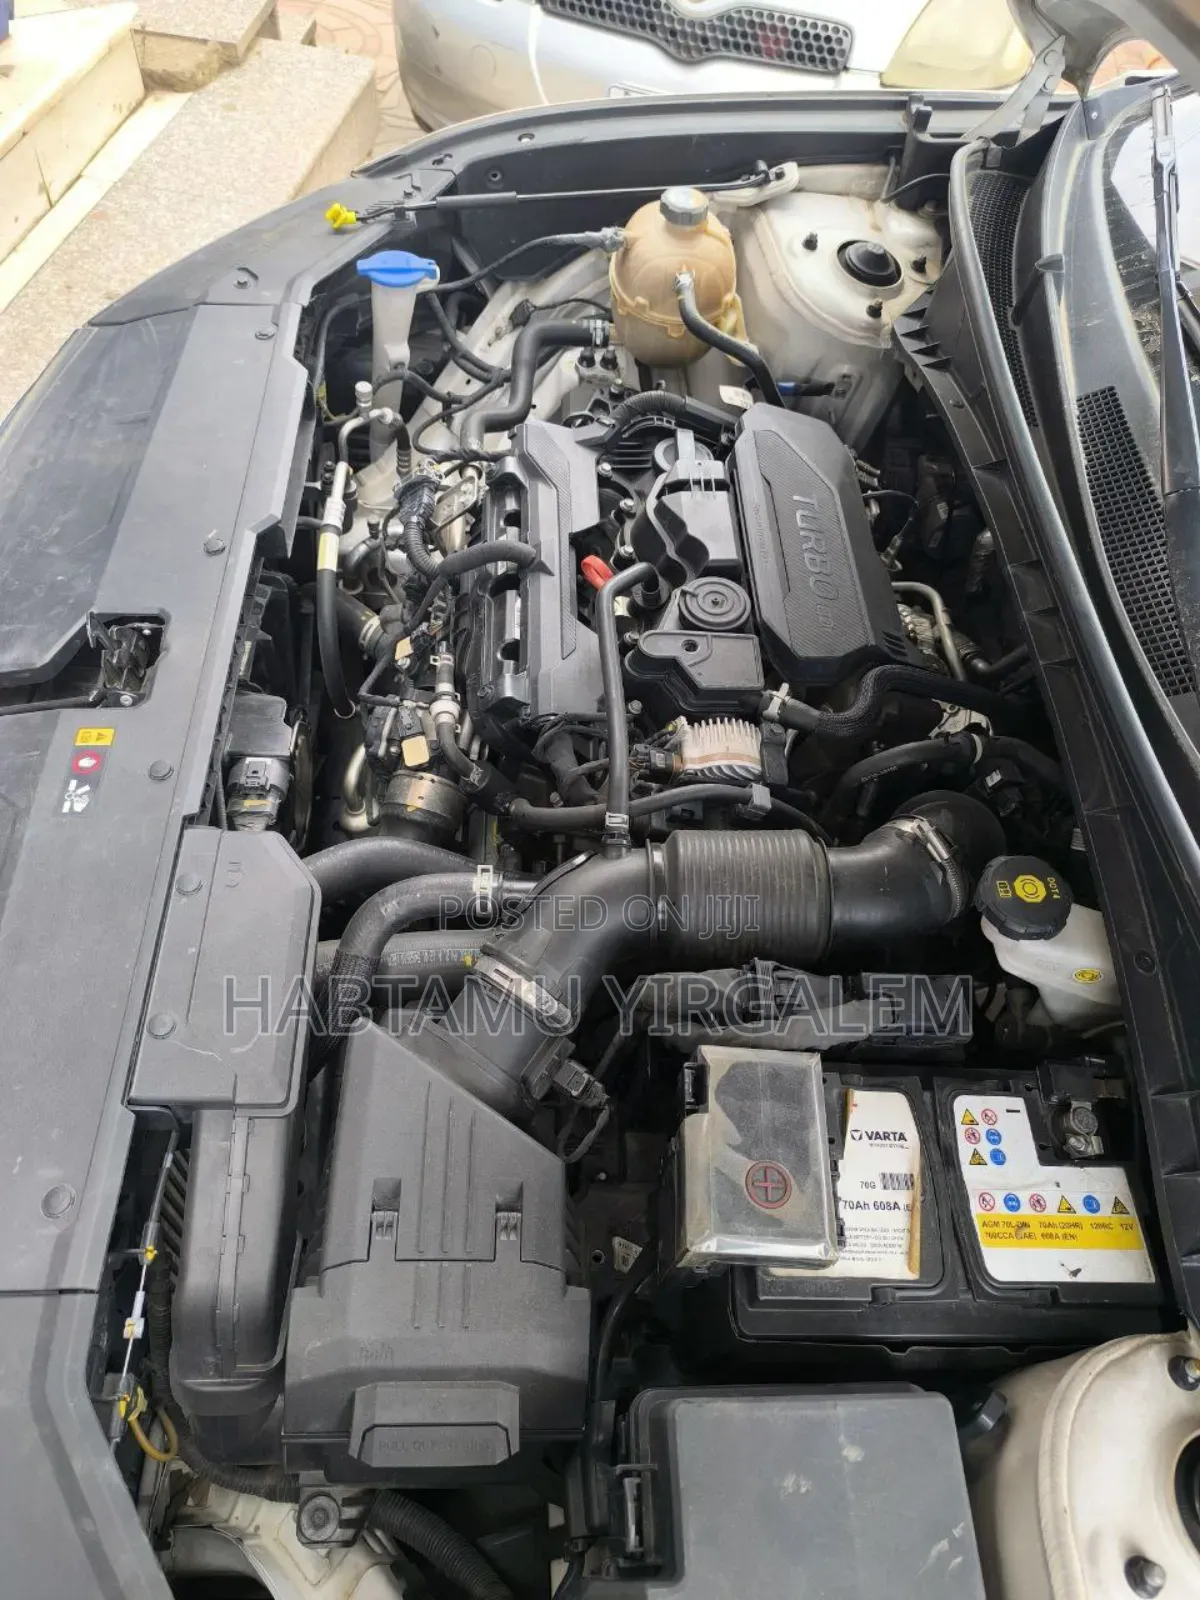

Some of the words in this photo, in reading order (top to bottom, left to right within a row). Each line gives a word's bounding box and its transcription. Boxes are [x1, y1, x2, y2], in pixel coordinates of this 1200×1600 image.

[793, 494, 839, 601] TURBO
[865, 1130, 908, 1142] VARTA
[842, 1199, 870, 1211] 70Ah
[873, 1200, 901, 1211] 608A
[982, 1220, 1000, 1228] AGM
